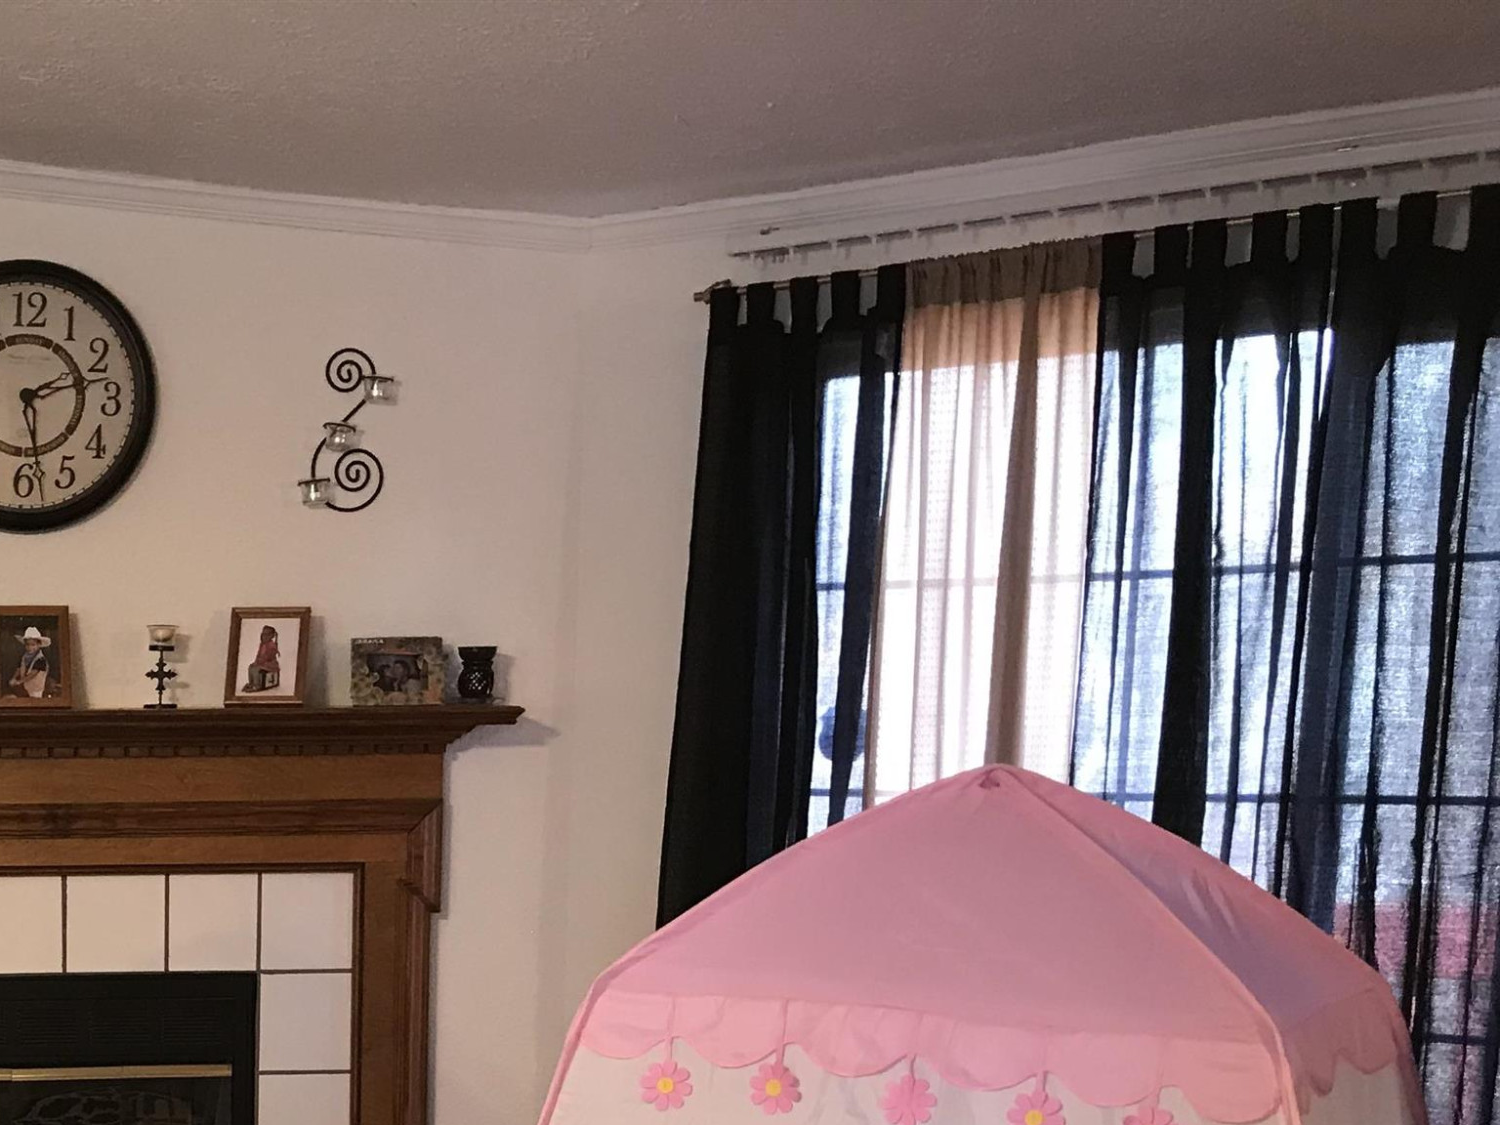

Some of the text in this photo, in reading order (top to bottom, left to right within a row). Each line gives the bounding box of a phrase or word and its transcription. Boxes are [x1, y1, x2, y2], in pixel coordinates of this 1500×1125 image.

[12, 292, 47, 327] 12
[63, 306, 76, 340] 1
[88, 338, 108, 372] 2
[101, 382, 121, 416] 3
[85, 424, 106, 458] 4
[13, 464, 34, 497] 6
[55, 456, 75, 488] 5
